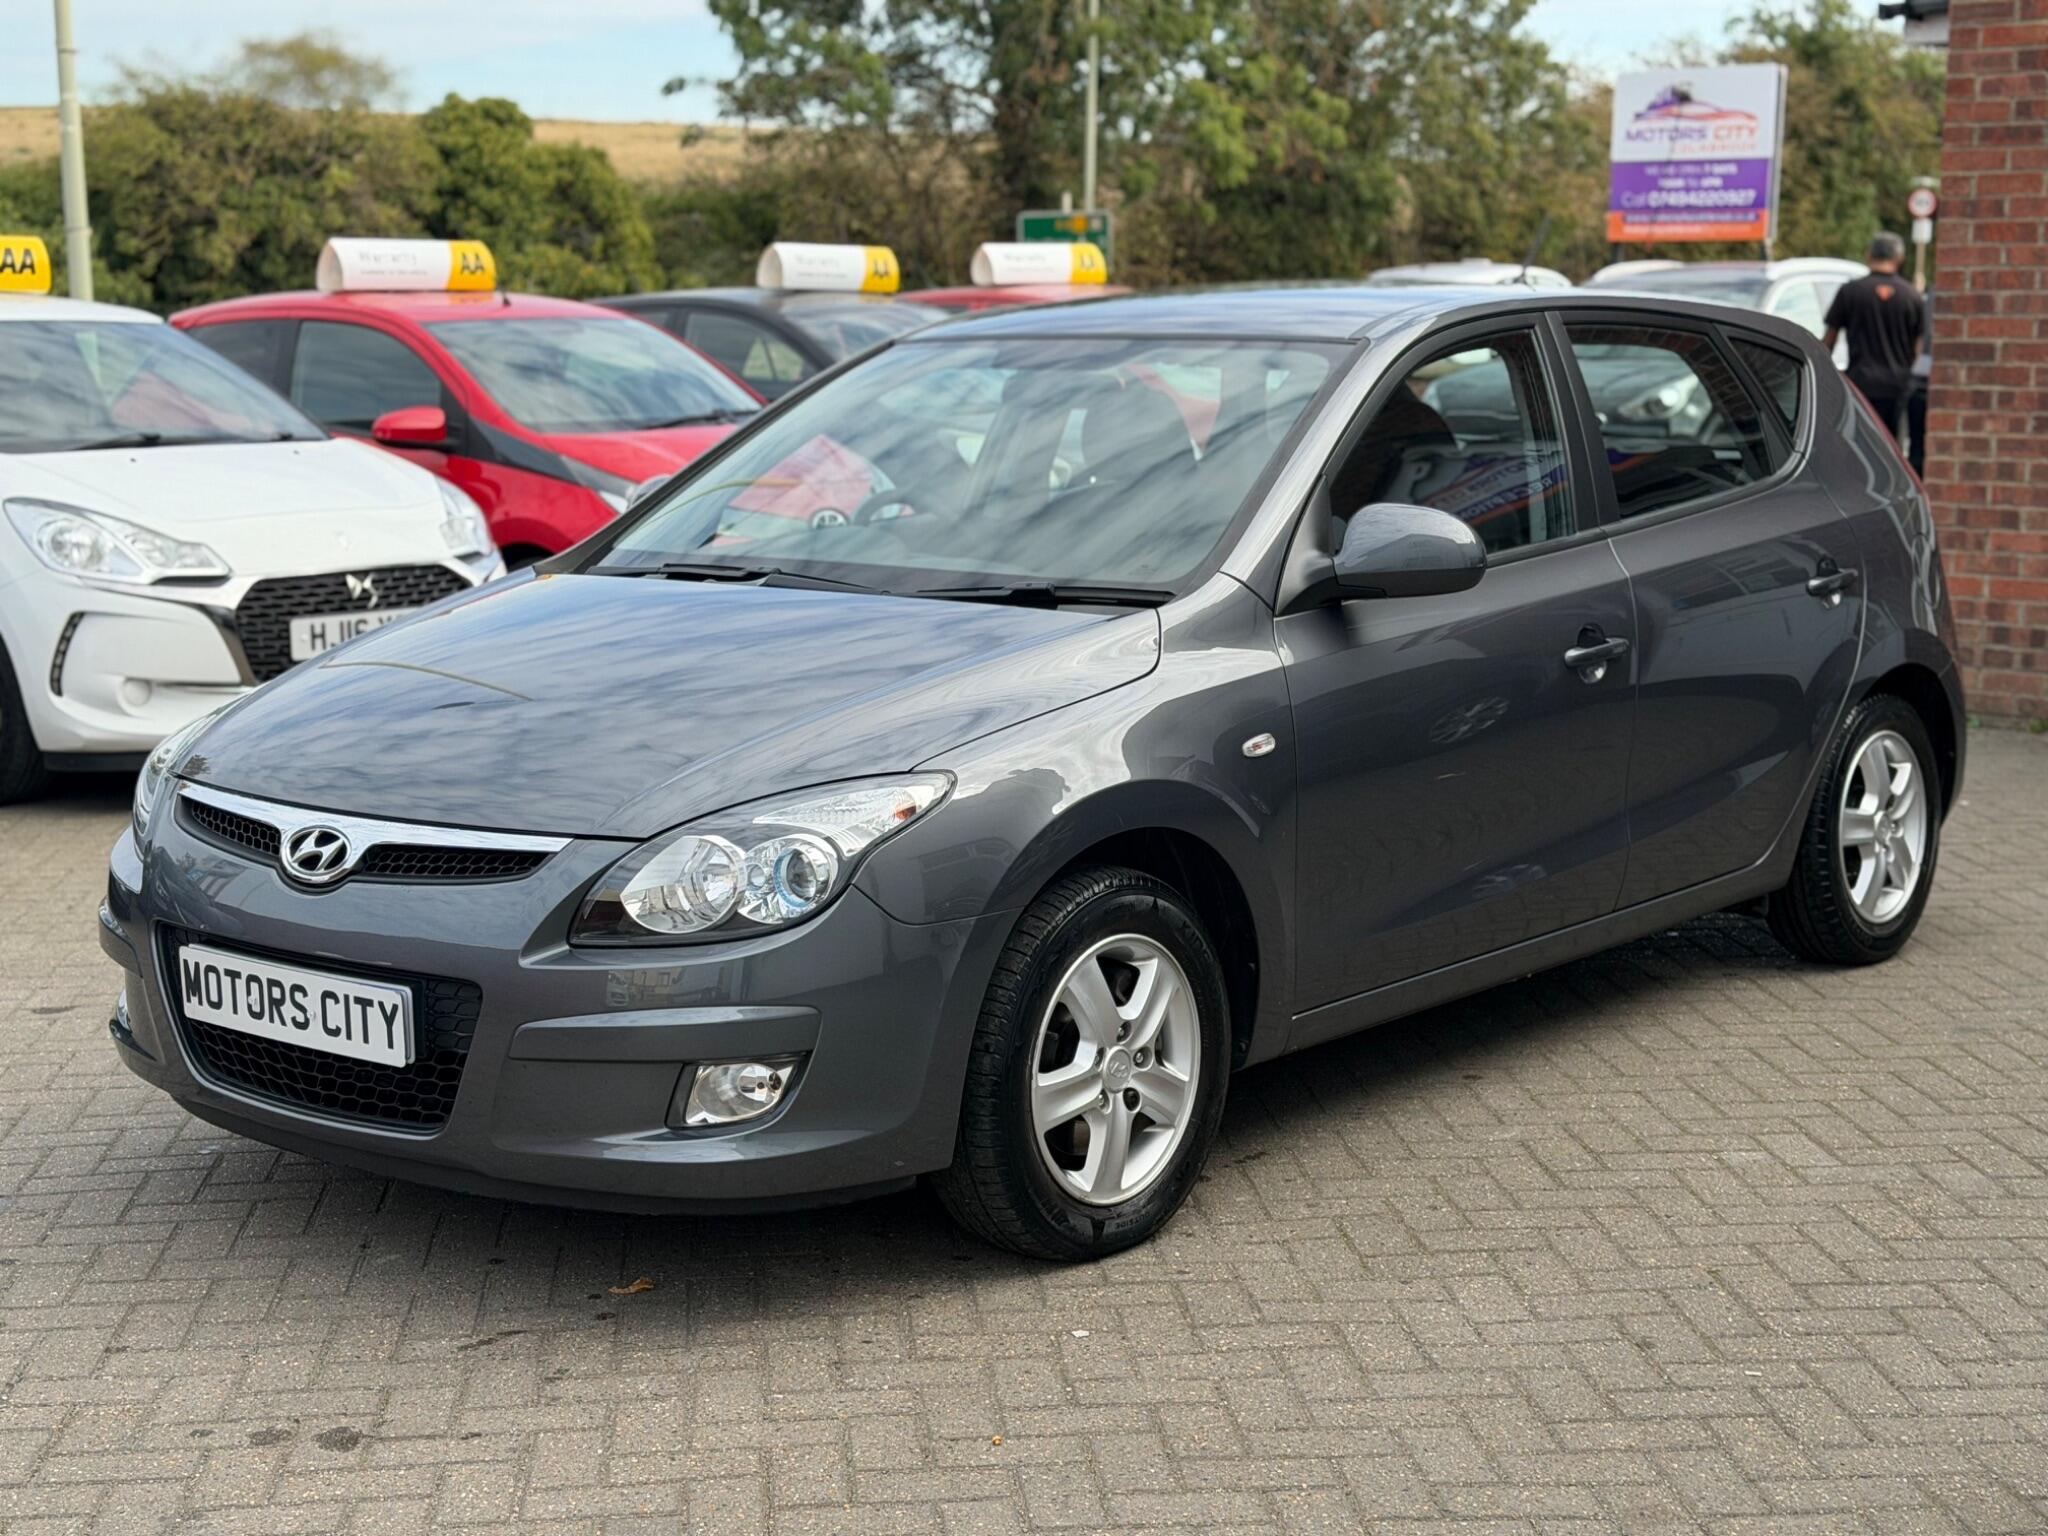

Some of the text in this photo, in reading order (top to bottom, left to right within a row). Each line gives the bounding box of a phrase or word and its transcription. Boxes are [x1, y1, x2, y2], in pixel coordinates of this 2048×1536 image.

[1625, 124, 1758, 142] MOTORS CITY
[0, 248, 36, 275] AA
[460, 252, 485, 275] AA
[182, 958, 399, 1050] MOTORS CITY
